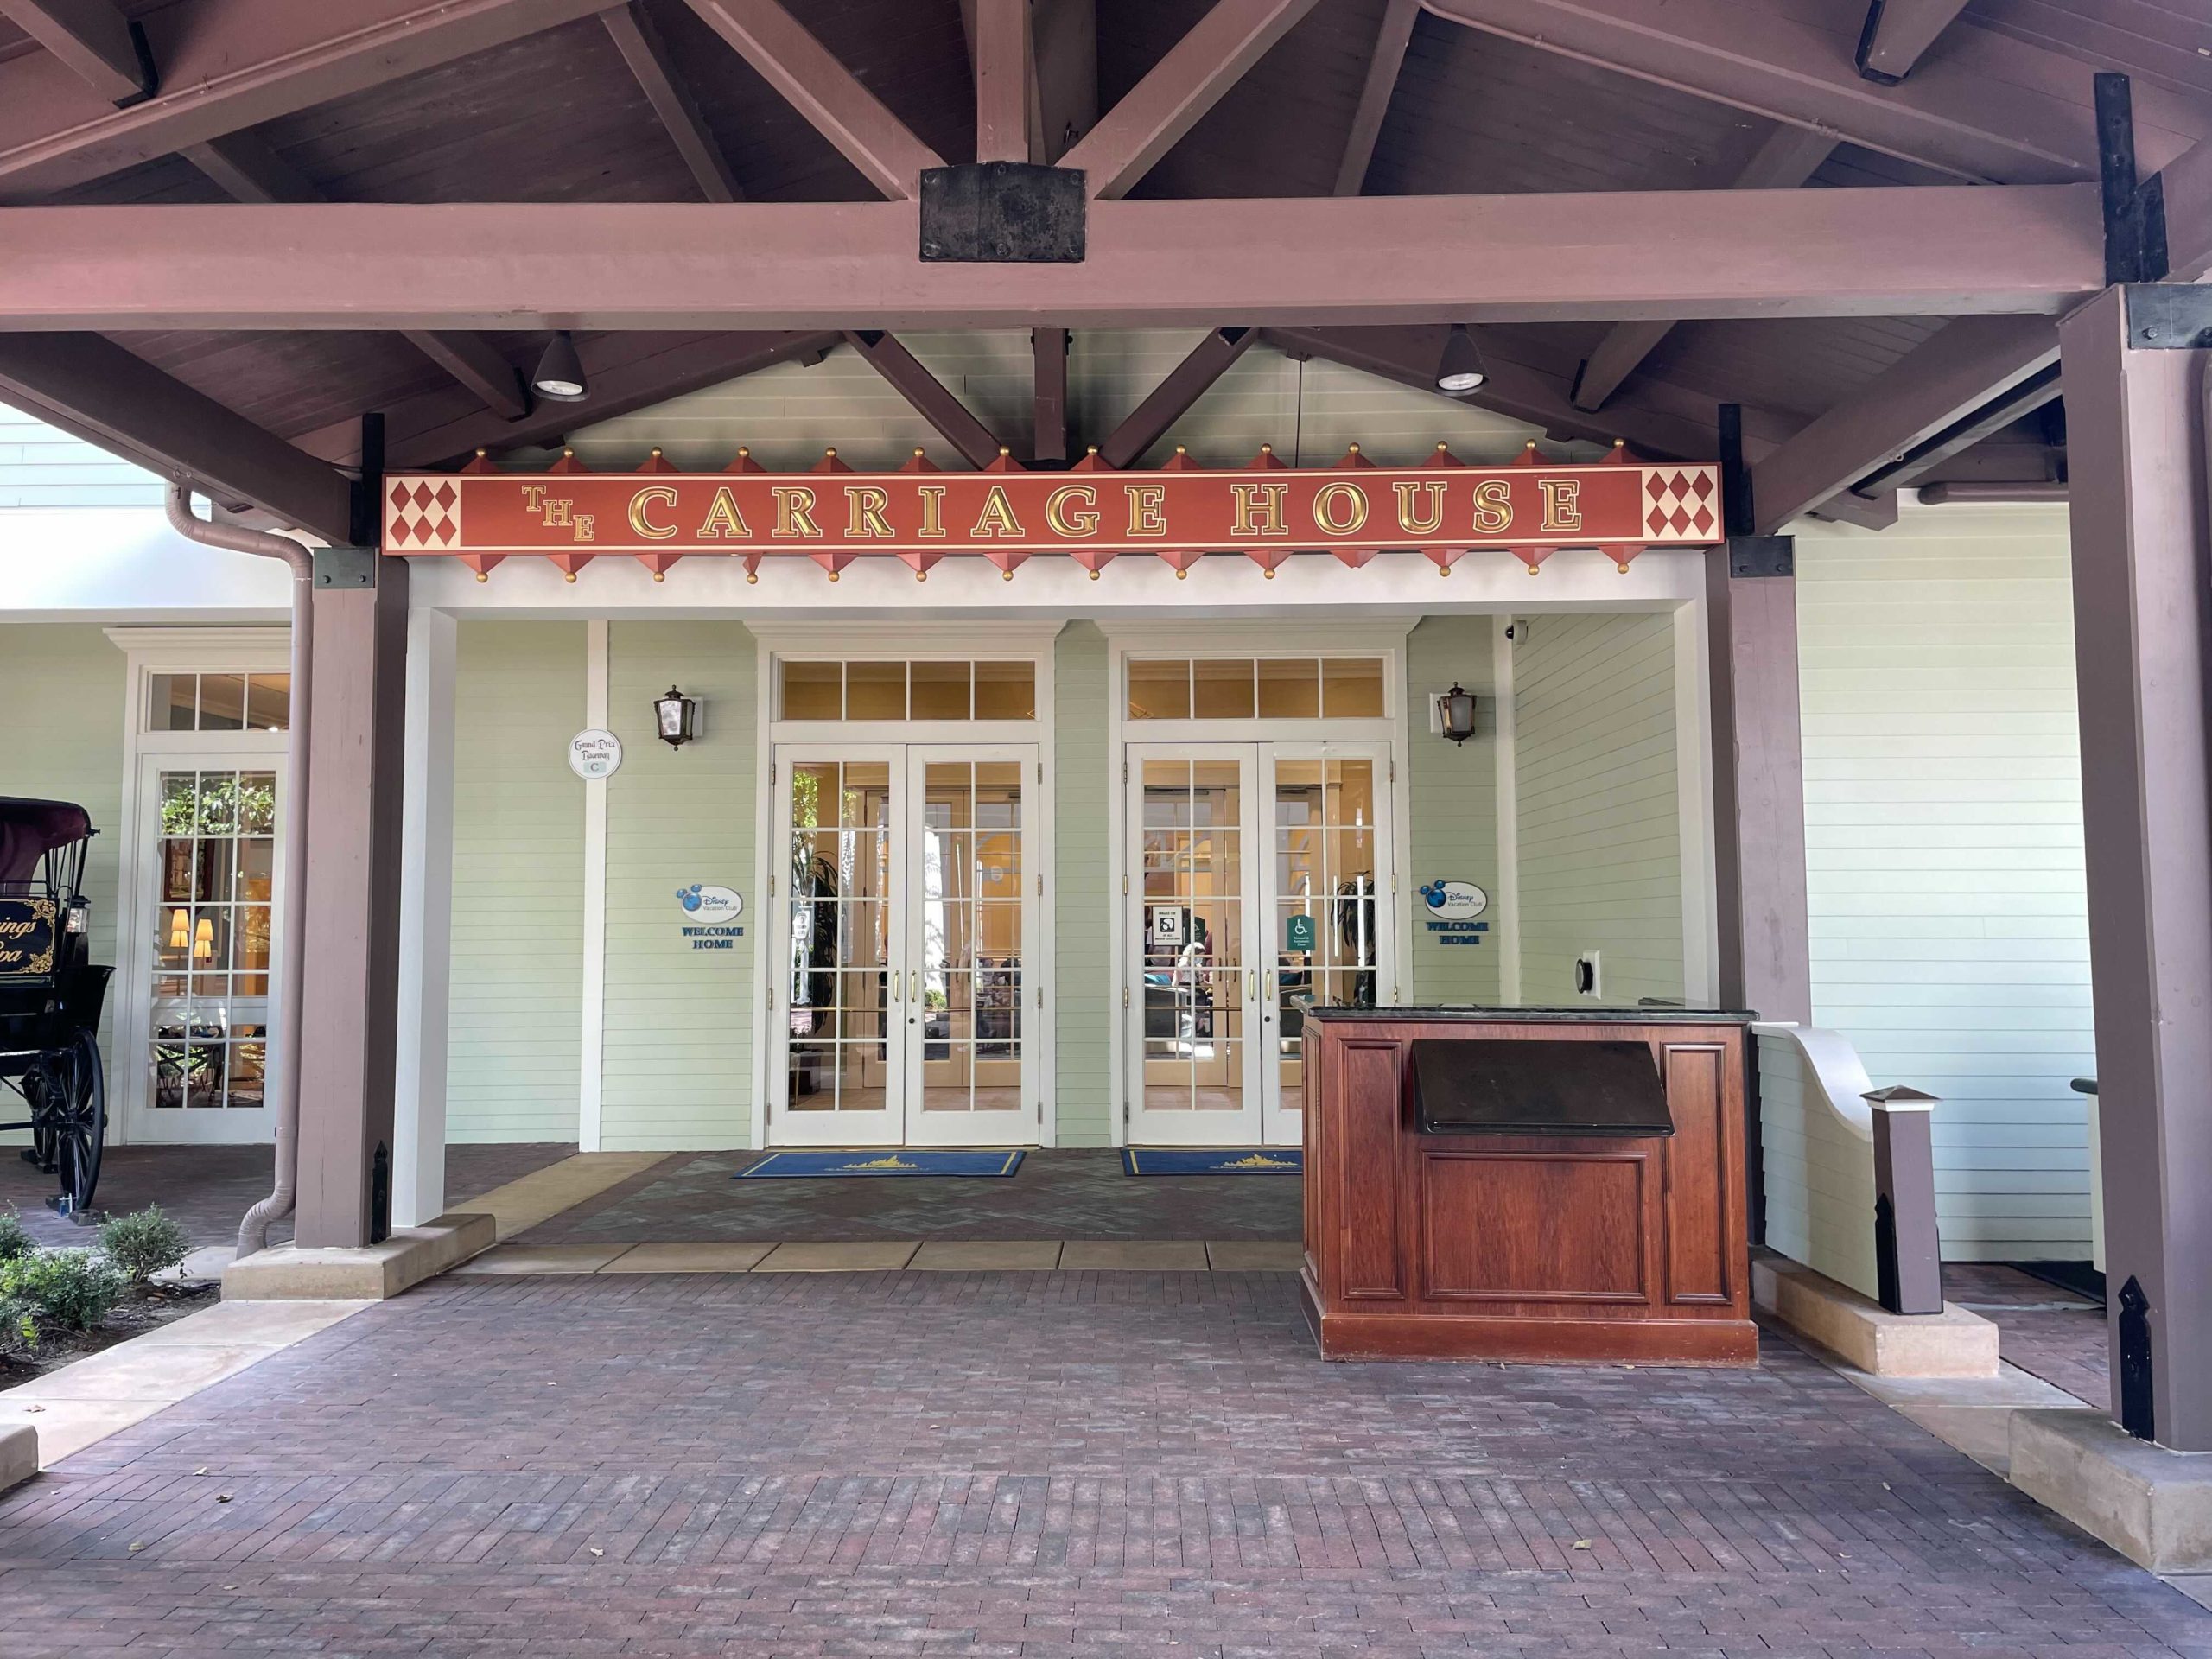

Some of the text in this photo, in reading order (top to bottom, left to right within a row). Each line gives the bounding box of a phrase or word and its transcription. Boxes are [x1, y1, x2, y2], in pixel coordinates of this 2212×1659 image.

[522, 479, 1583, 541] THE CARRIAGE HOUSE
[575, 740, 596, 751] Grand
[590, 762, 600, 772] C
[701, 895, 729, 907] Disney
[1446, 891, 1474, 903] Disney
[0, 917, 36, 939] ings
[682, 926, 744, 937] WELCOME
[1426, 921, 1489, 931] WELCOME
[692, 939, 734, 950] HOME
[1439, 935, 1480, 945] HOME
